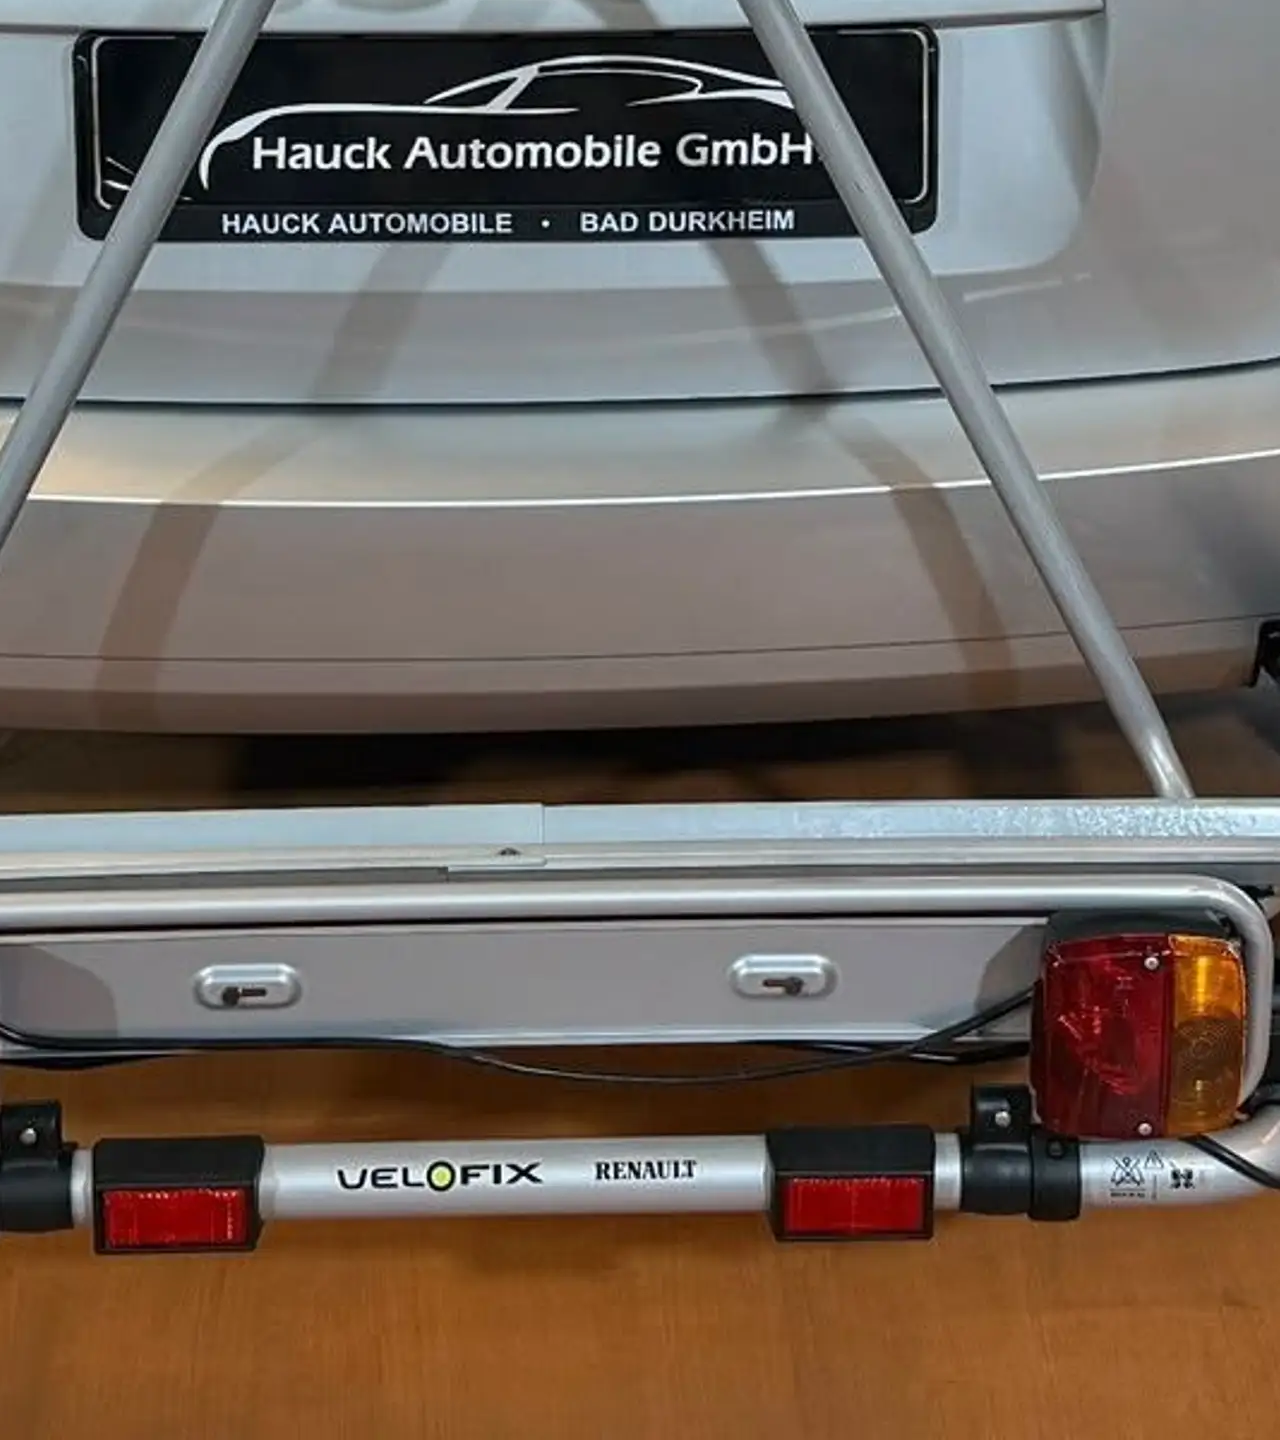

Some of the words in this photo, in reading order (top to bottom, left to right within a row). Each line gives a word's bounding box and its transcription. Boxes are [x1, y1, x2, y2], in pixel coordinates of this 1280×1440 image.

[252, 136, 392, 170] Hauck
[402, 133, 661, 170] Automobile
[675, 132, 814, 167] GmbH
[221, 212, 321, 235] HAUCK
[327, 212, 513, 235] AUTOMOBILE
[580, 211, 639, 233] BAD
[648, 209, 795, 233] DURKHEIM
[337, 1160, 543, 1192] VELOFIX
[594, 1159, 697, 1181] RENAULT
